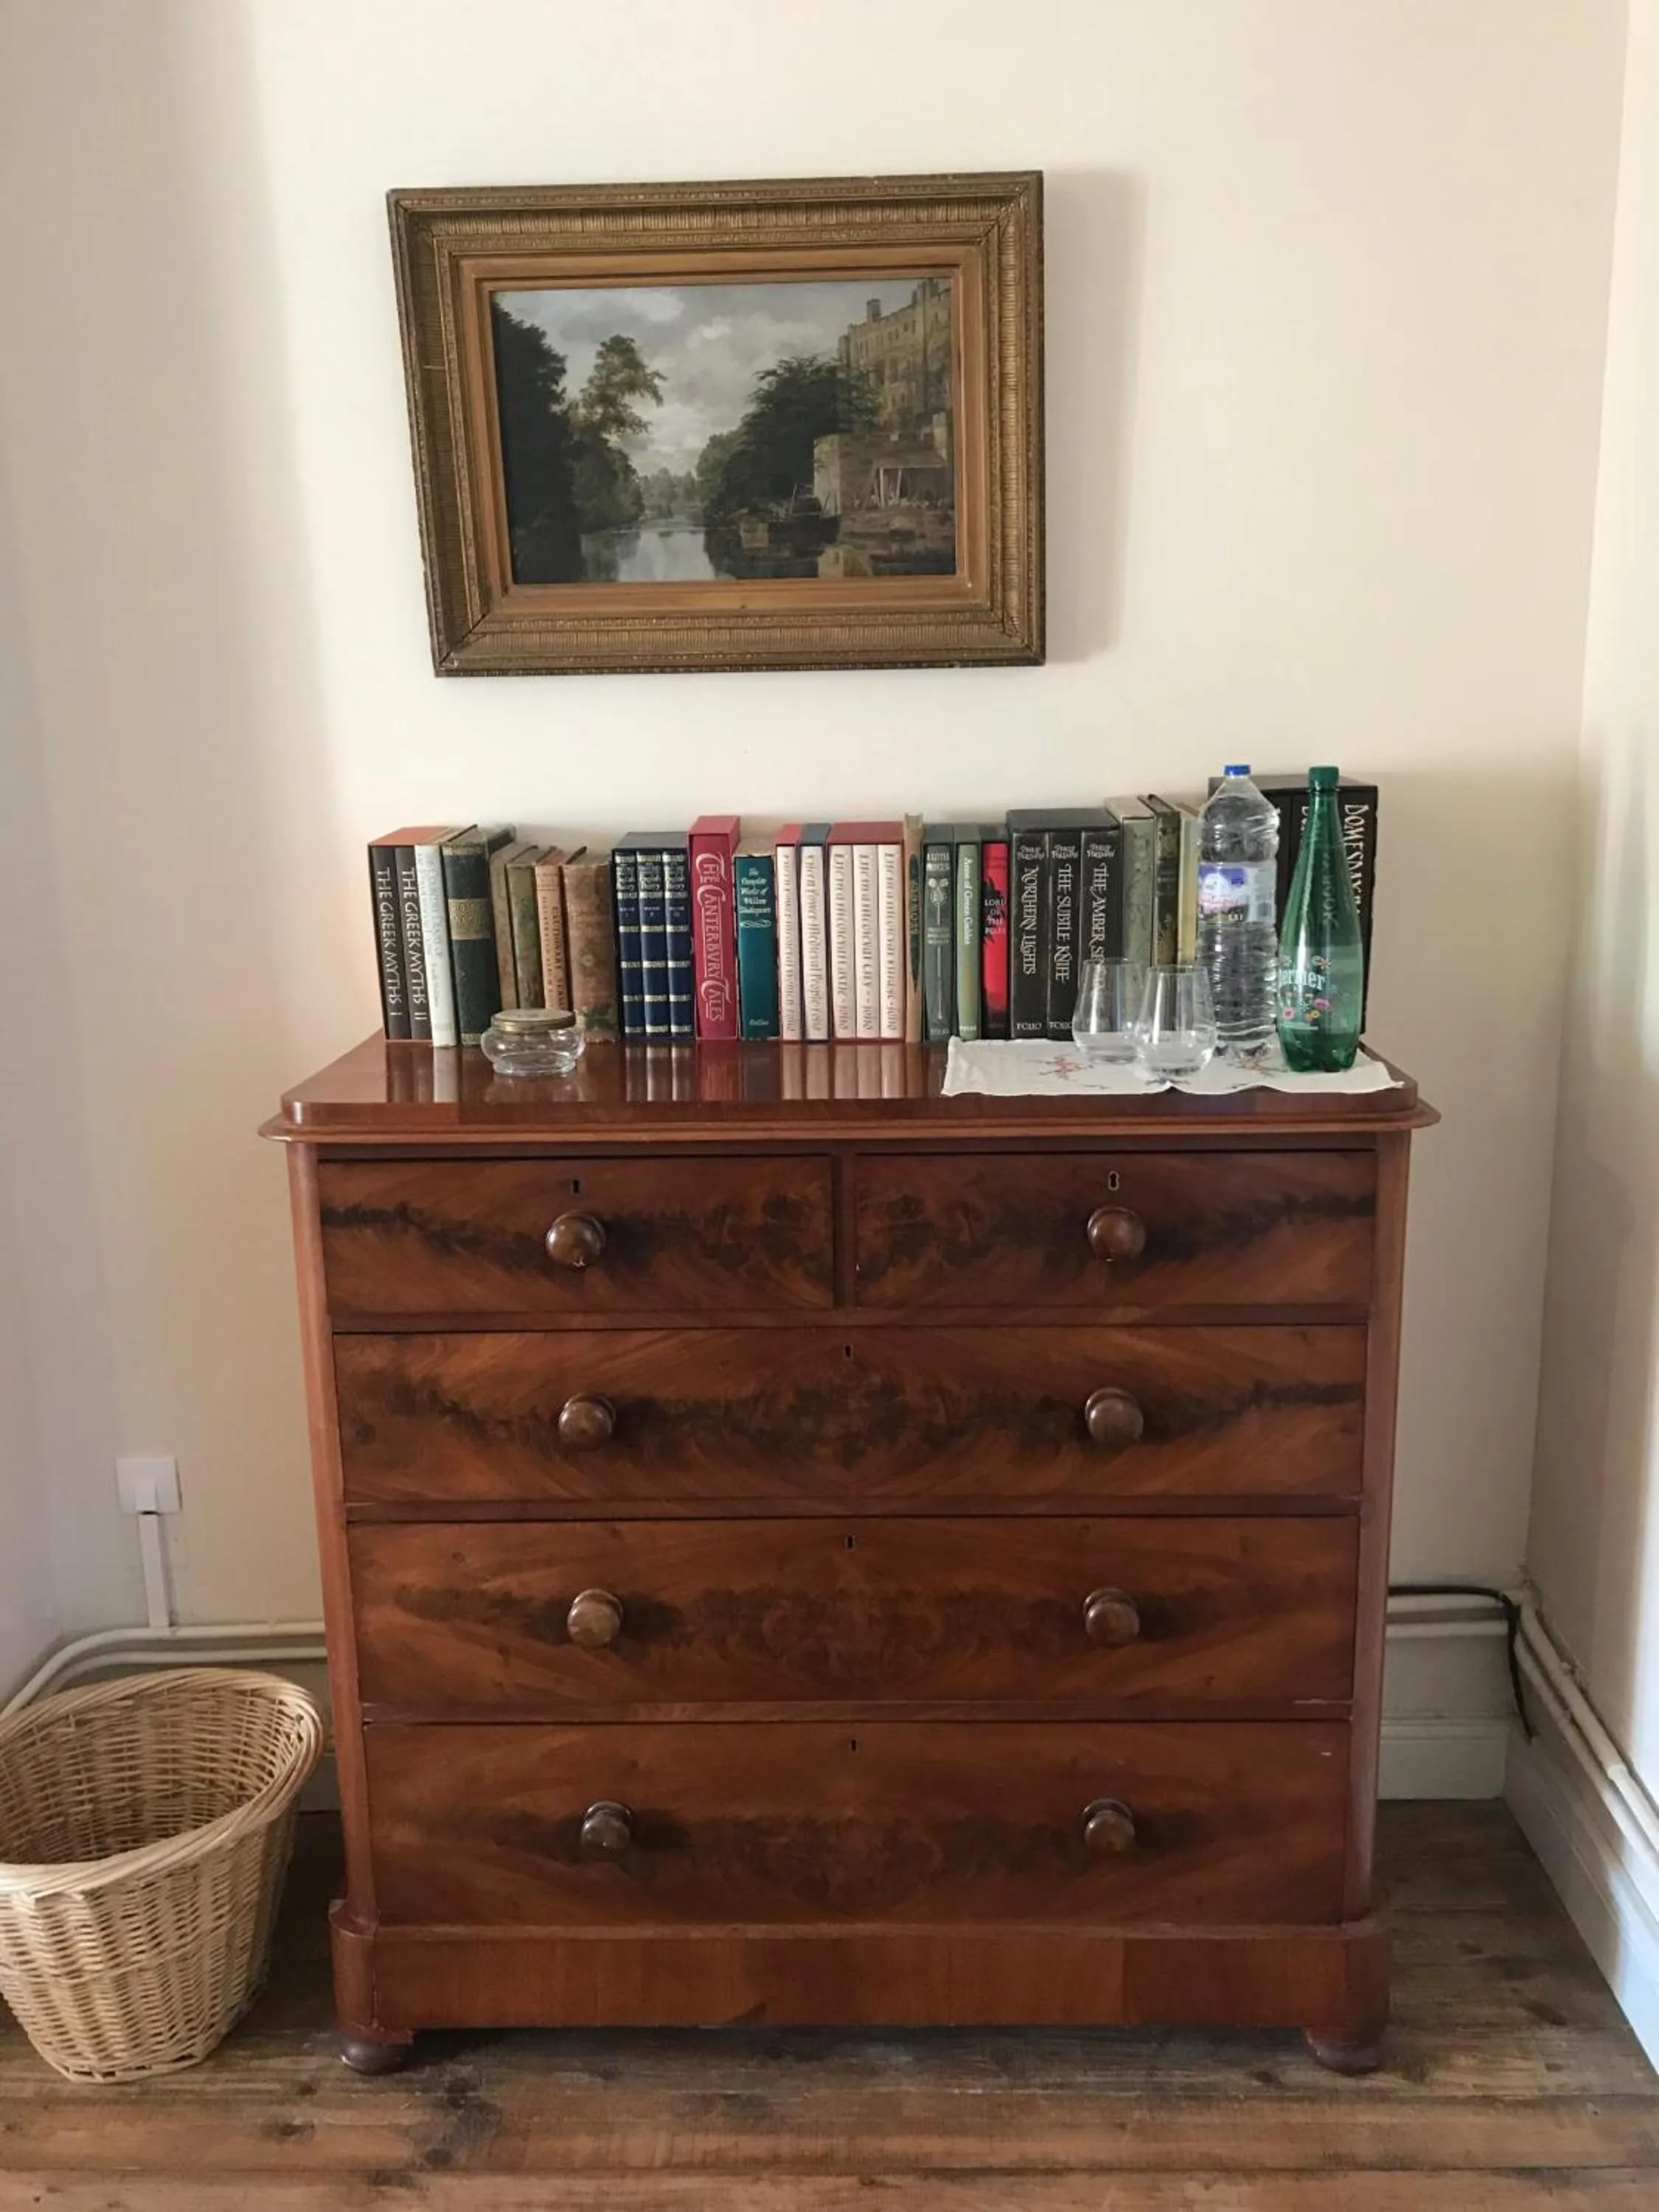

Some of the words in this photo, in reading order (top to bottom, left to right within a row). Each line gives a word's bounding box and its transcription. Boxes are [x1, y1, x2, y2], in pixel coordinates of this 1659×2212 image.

[377, 866, 392, 898] THE
[402, 866, 417, 898] THE
[695, 852, 727, 884] THE
[964, 857, 974, 879] Anne
[1057, 863, 1074, 894] THE
[1093, 863, 1109, 894] THE
[1019, 866, 1040, 931] NORTHERN
[1057, 896, 1073, 942] SUBTLE
[1089, 886, 1106, 947] AMBER
[380, 902, 396, 948] GREEK
[405, 902, 421, 948] GREEK
[1020, 933, 1037, 975] LIGHTS
[1054, 945, 1074, 984] KNIFE
[384, 950, 402, 1004] MYTHS
[408, 950, 426, 1004] MYTHS
[414, 1011, 428, 1020] II
[700, 978, 731, 1021] TALES
